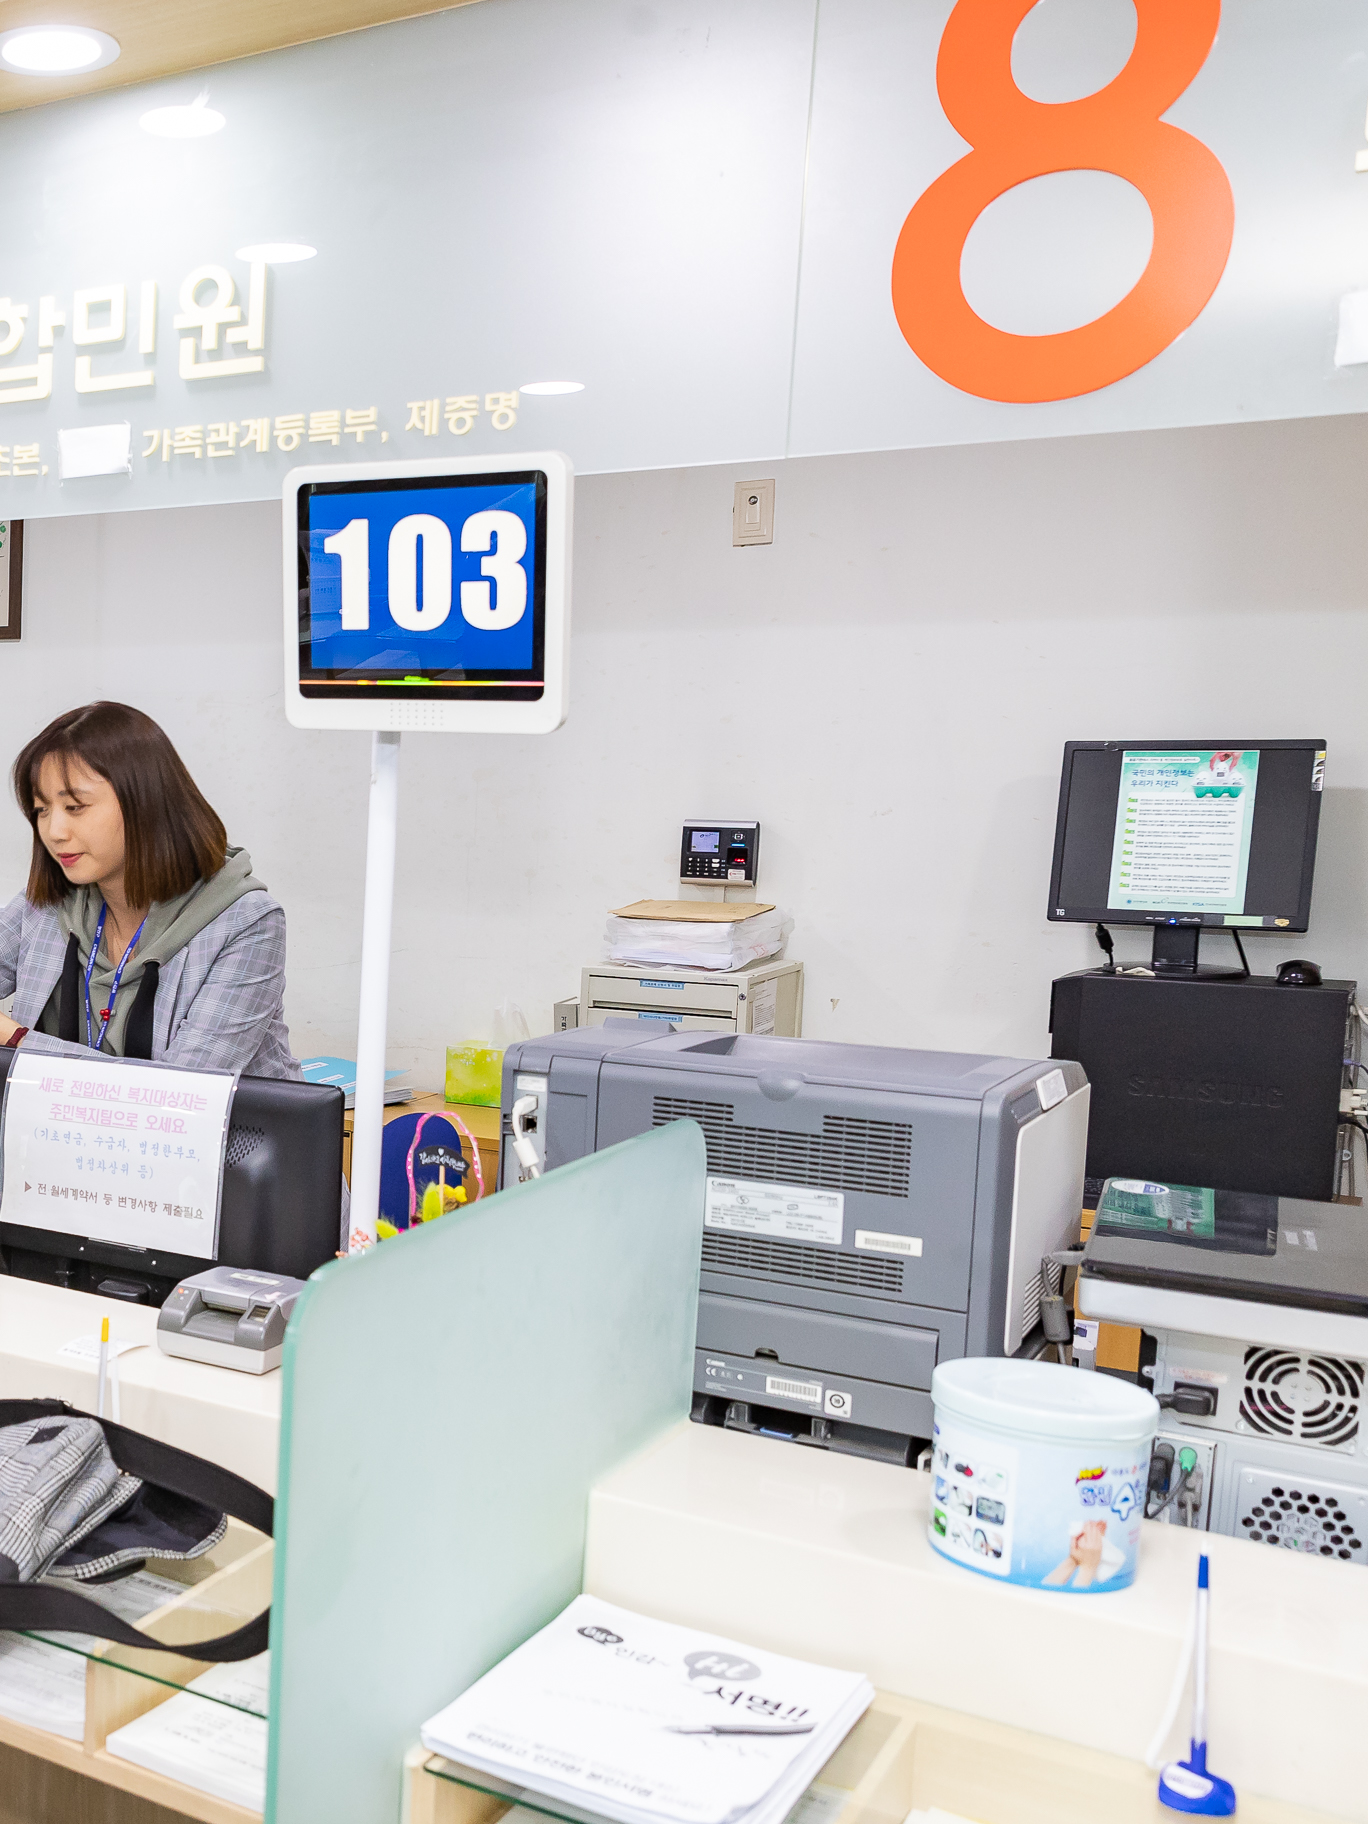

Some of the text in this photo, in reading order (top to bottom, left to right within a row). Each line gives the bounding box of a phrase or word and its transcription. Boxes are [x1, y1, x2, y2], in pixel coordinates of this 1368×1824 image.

[892, 0, 1235, 403] 8
[142, 405, 391, 464] 가족관계등록부,
[405, 390, 521, 437] 제증명
[323, 509, 528, 631] 103
[1055, 908, 1066, 916] TG
[38, 1076, 208, 1111] 새로 전입하신 복지대상자는
[49, 1103, 188, 1134] 주민복지팀으로 오세요.
[74, 1156, 154, 1180] 법정차상위 등)
[102, 1193, 113, 1206] 등
[117, 1195, 158, 1213] 변경사항
[162, 1202, 205, 1220] 제출필요
[703, 1685, 810, 1723] 서명!!
